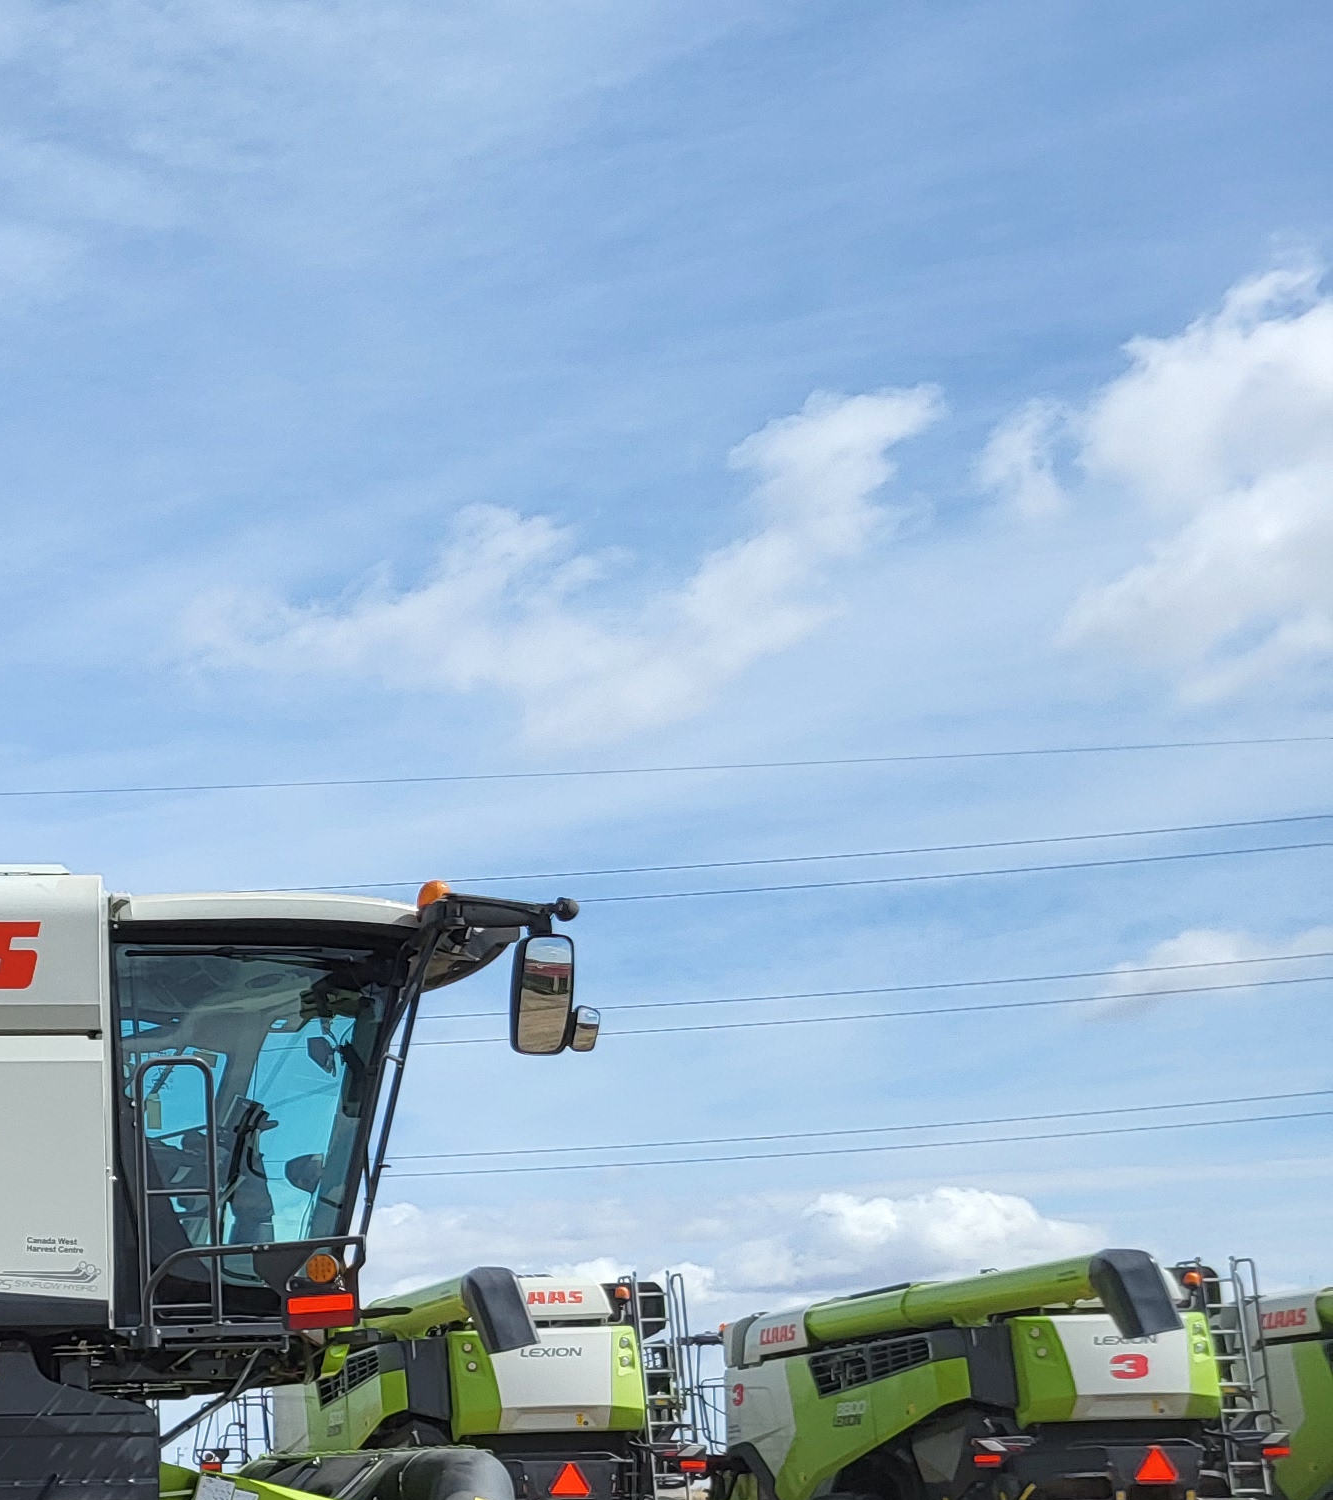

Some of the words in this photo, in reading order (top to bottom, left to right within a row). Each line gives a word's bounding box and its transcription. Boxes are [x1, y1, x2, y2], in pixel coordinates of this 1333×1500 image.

[26, 1236, 56, 1245] Canada
[58, 1238, 78, 1246] West
[26, 1245, 56, 1253] Harvest
[58, 1246, 84, 1254] Centre
[526, 1290, 583, 1305] AAS
[759, 1324, 796, 1345] CLAAS
[1093, 1335, 1157, 1346] LEXON
[520, 1347, 583, 1358] LEXION
[1109, 1353, 1149, 1380] 3
[732, 1383, 744, 1407] 3
